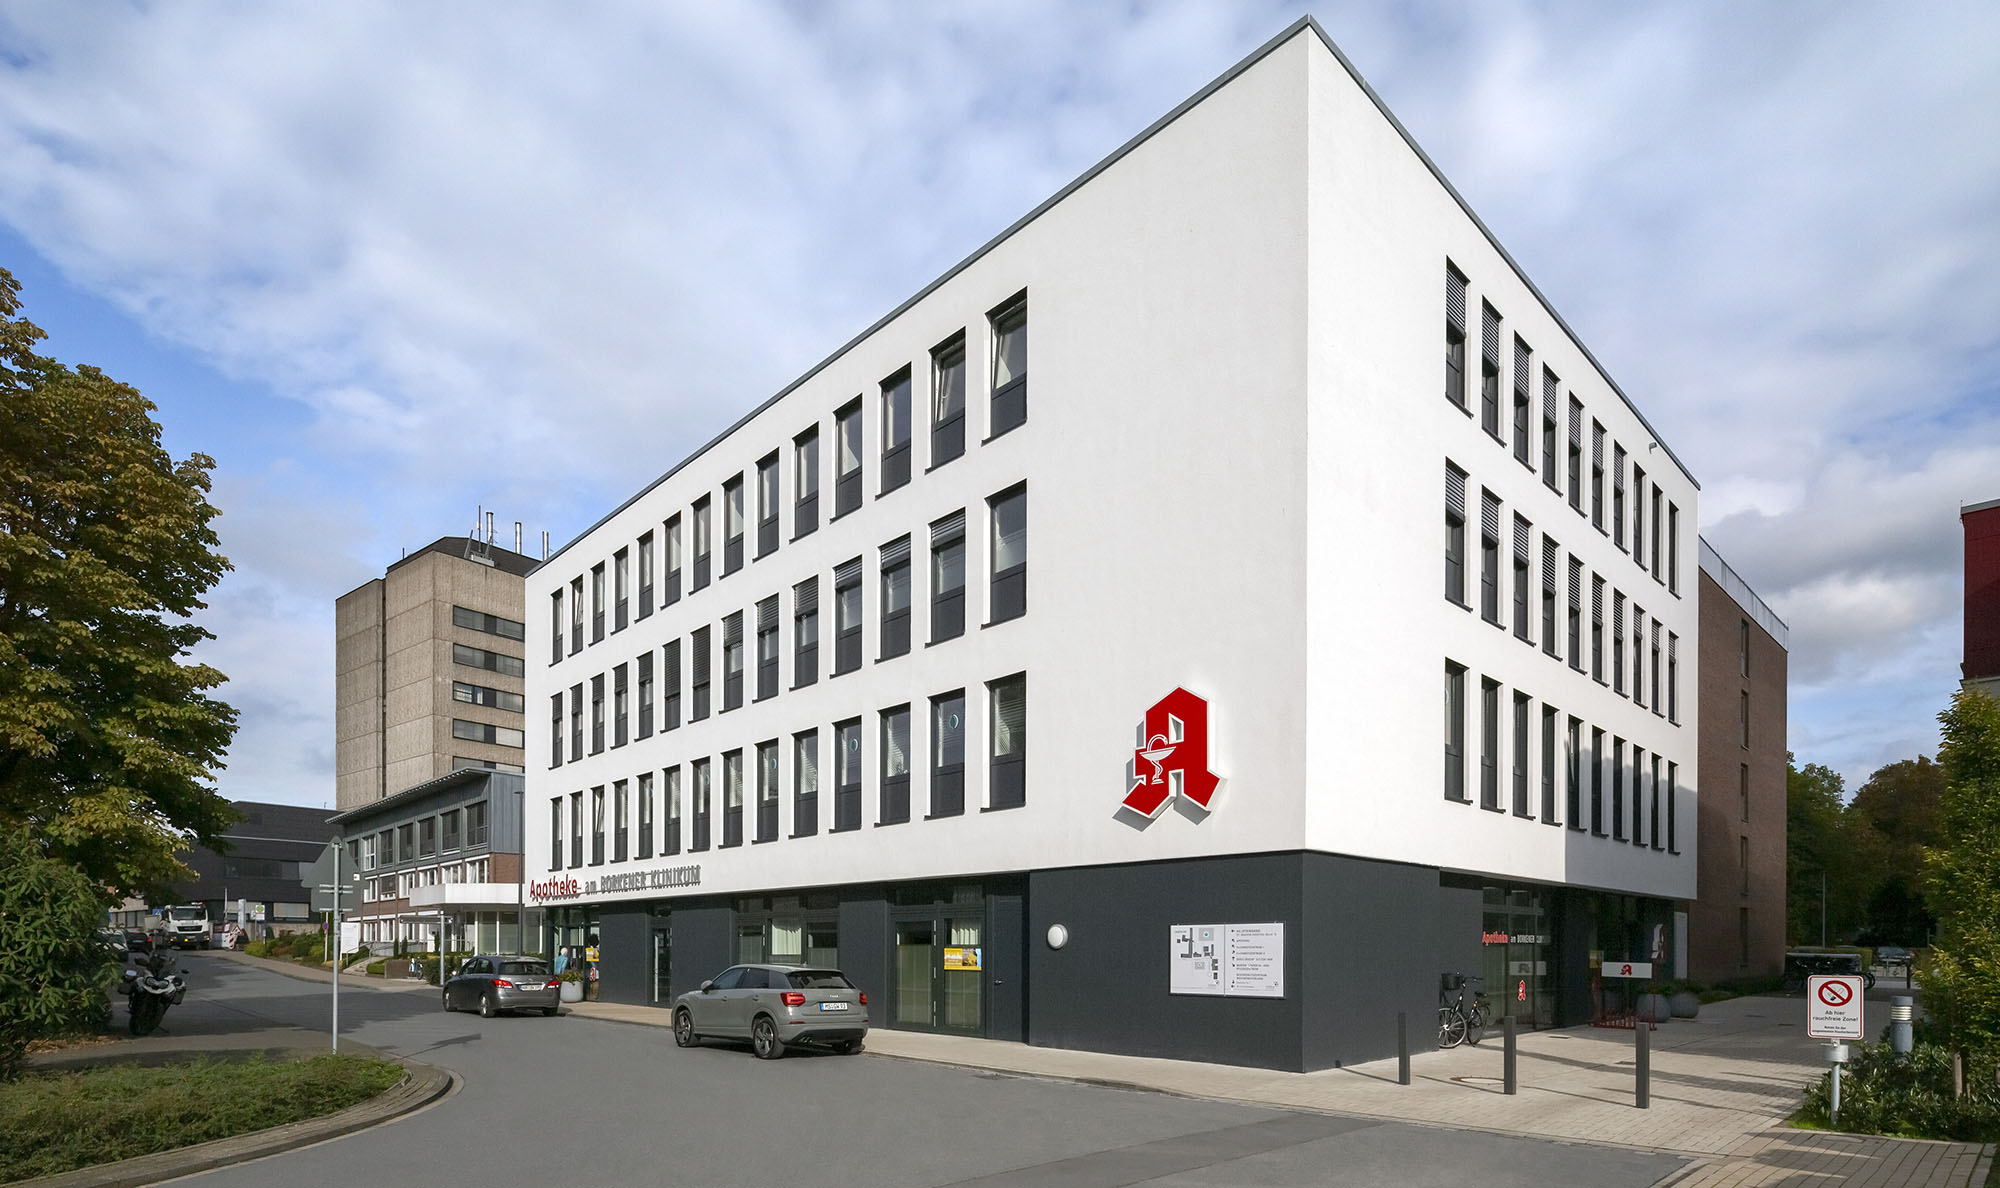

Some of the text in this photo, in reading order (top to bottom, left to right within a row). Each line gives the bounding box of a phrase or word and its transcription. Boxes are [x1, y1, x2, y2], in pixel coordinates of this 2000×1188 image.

[529, 865, 701, 899] Apotheke am BORKENER KLINIKUM
